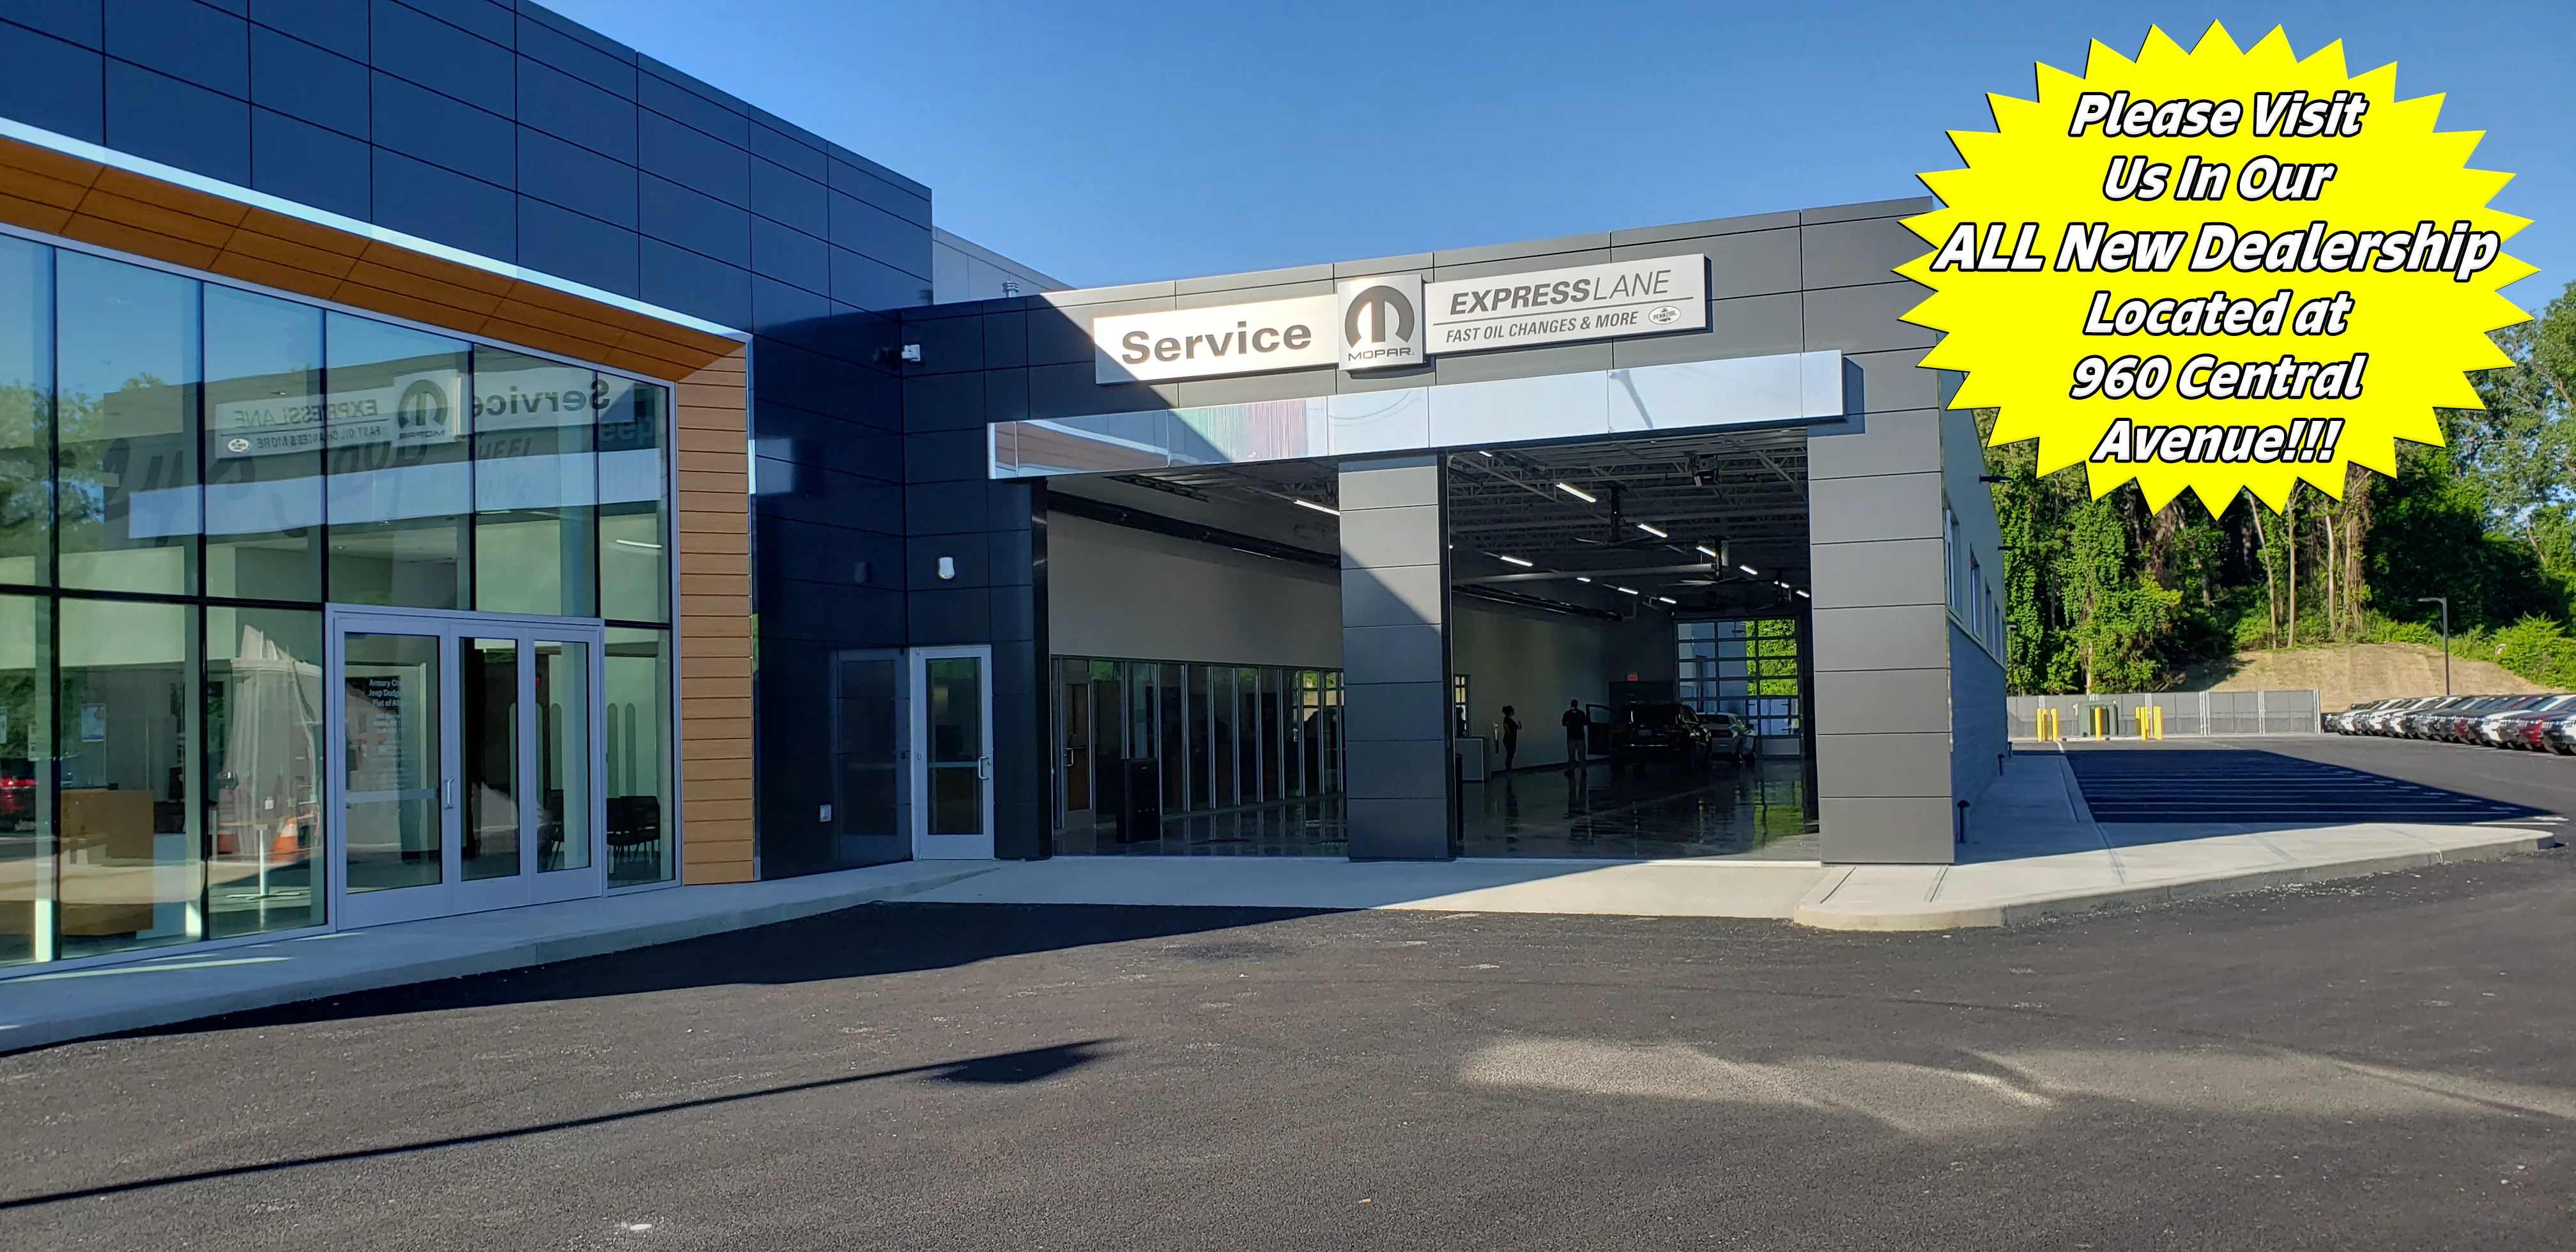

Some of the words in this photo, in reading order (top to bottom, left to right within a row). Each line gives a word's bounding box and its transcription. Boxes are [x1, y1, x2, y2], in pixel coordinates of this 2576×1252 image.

[1122, 321, 1312, 365] Service
[1446, 327, 1481, 344] FAST
[1483, 324, 1505, 340] OIL
[1510, 316, 1577, 337] CHANGES
[1580, 316, 1591, 330] &
[1595, 310, 1639, 328] MORE
